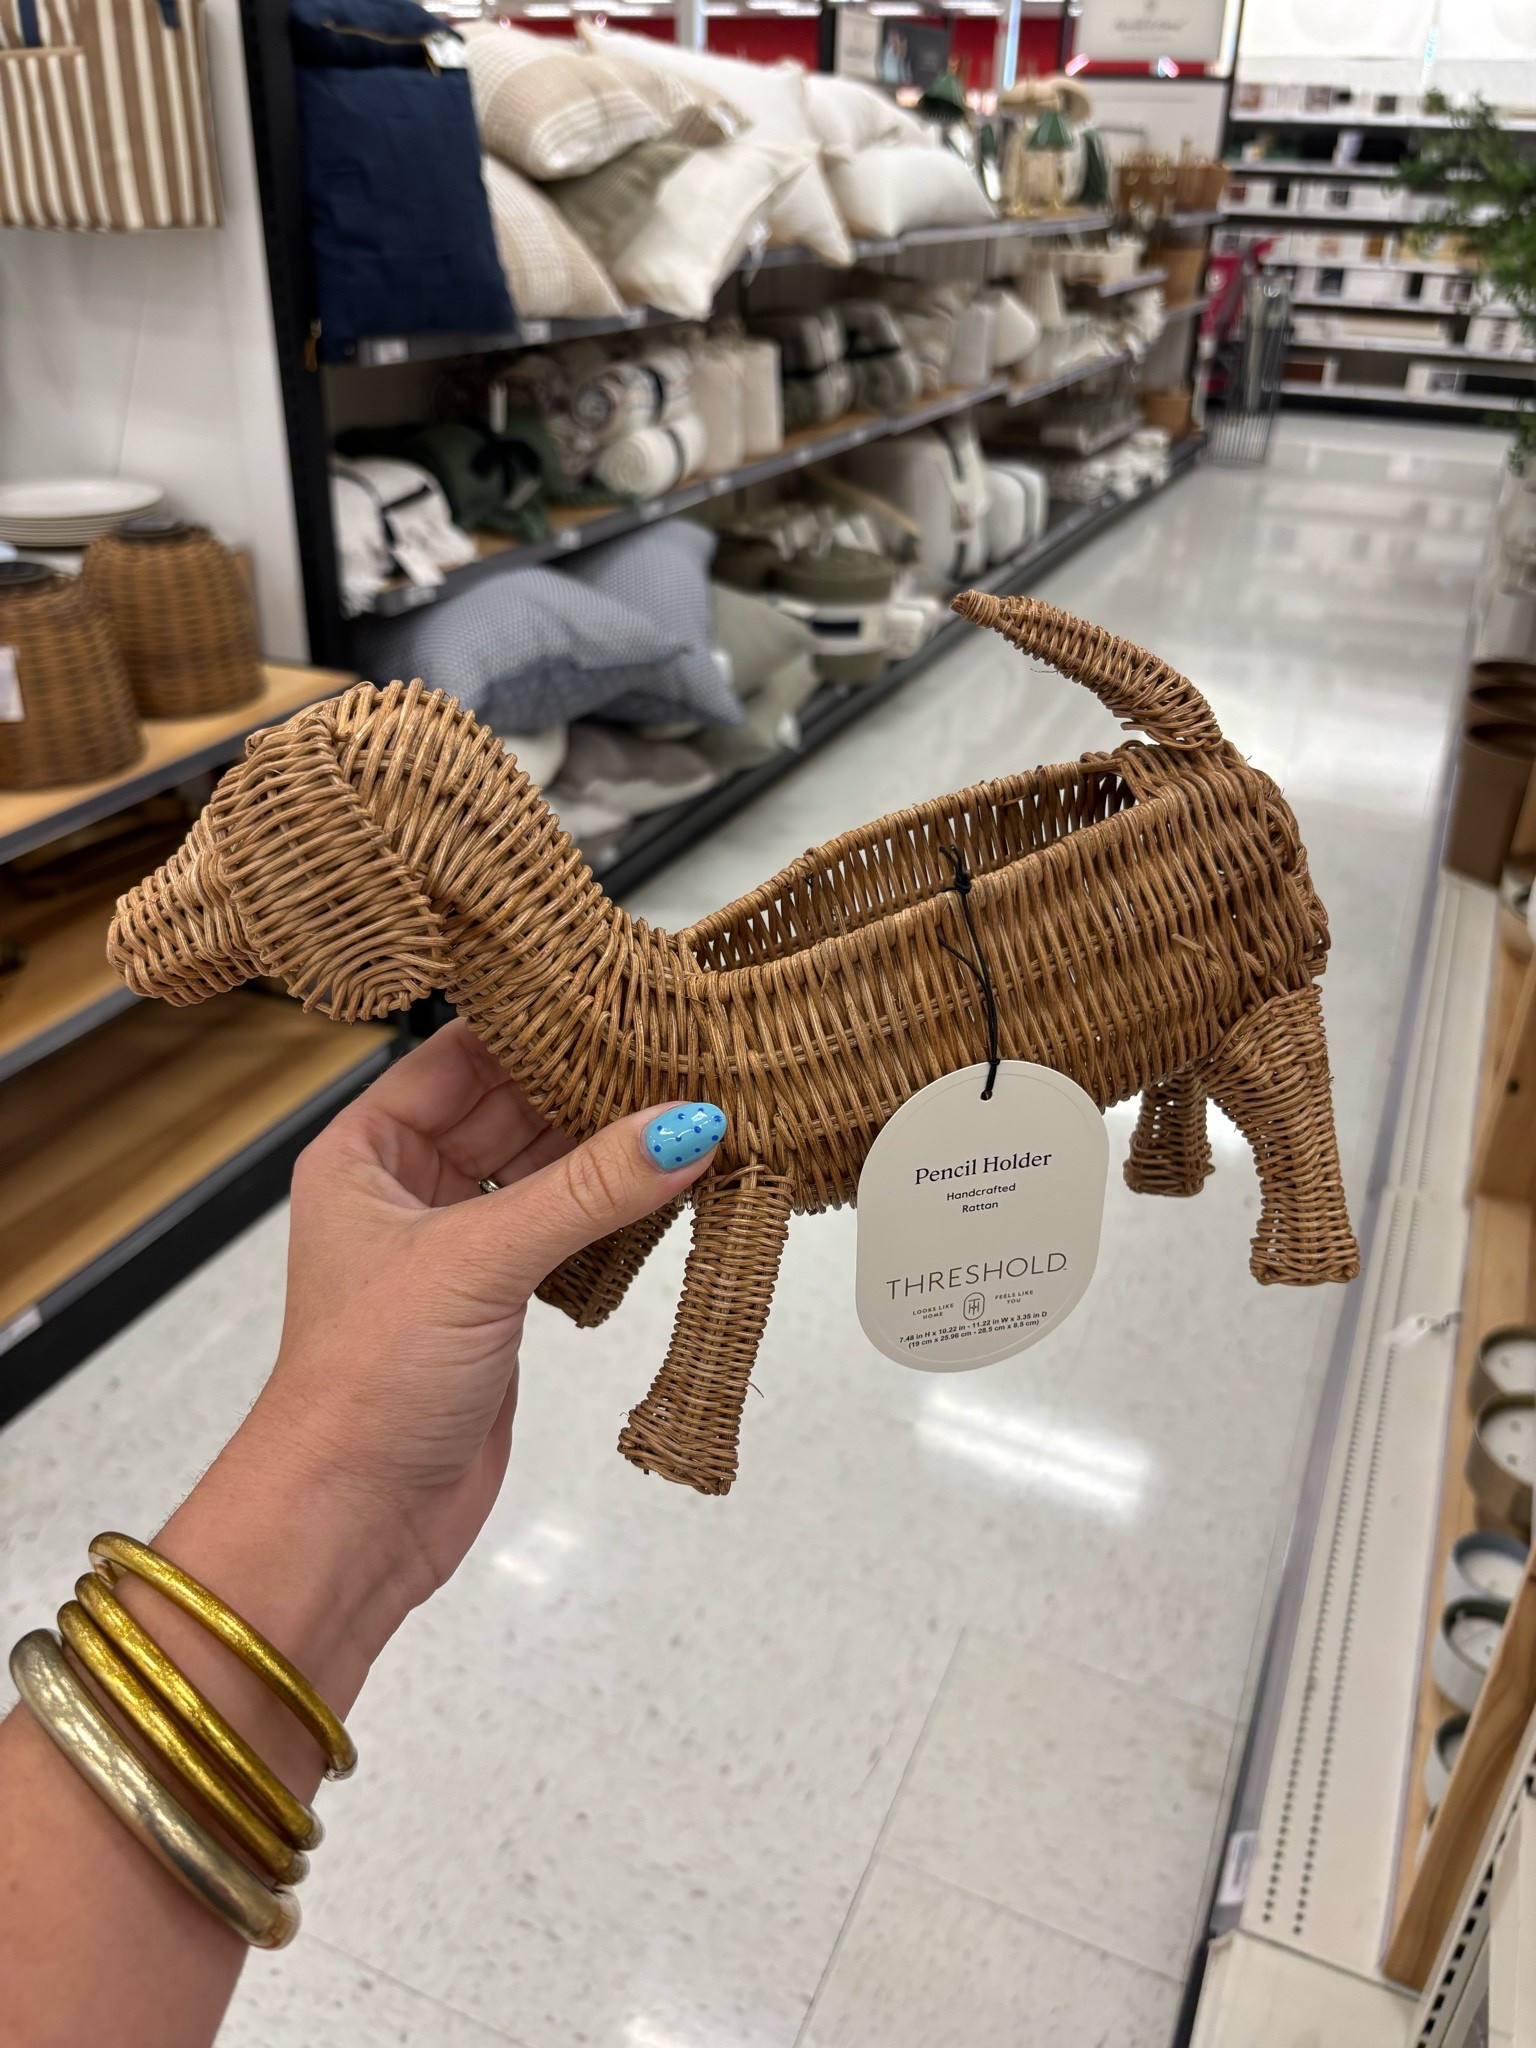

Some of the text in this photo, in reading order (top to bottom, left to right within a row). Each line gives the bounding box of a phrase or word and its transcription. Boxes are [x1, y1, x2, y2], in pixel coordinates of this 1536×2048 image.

[915, 1151, 1052, 1185] Pencil Holder
[947, 1183, 1016, 1201] Handcrafted
[962, 1201, 999, 1213] Rattan
[886, 1252, 1067, 1300] THRESHOLD
[913, 1307, 936, 1315] LOOKS
[923, 1312, 943, 1320] HOME
[939, 1326, 957, 1334] 10.22
[972, 1320, 990, 1328] 11.22
